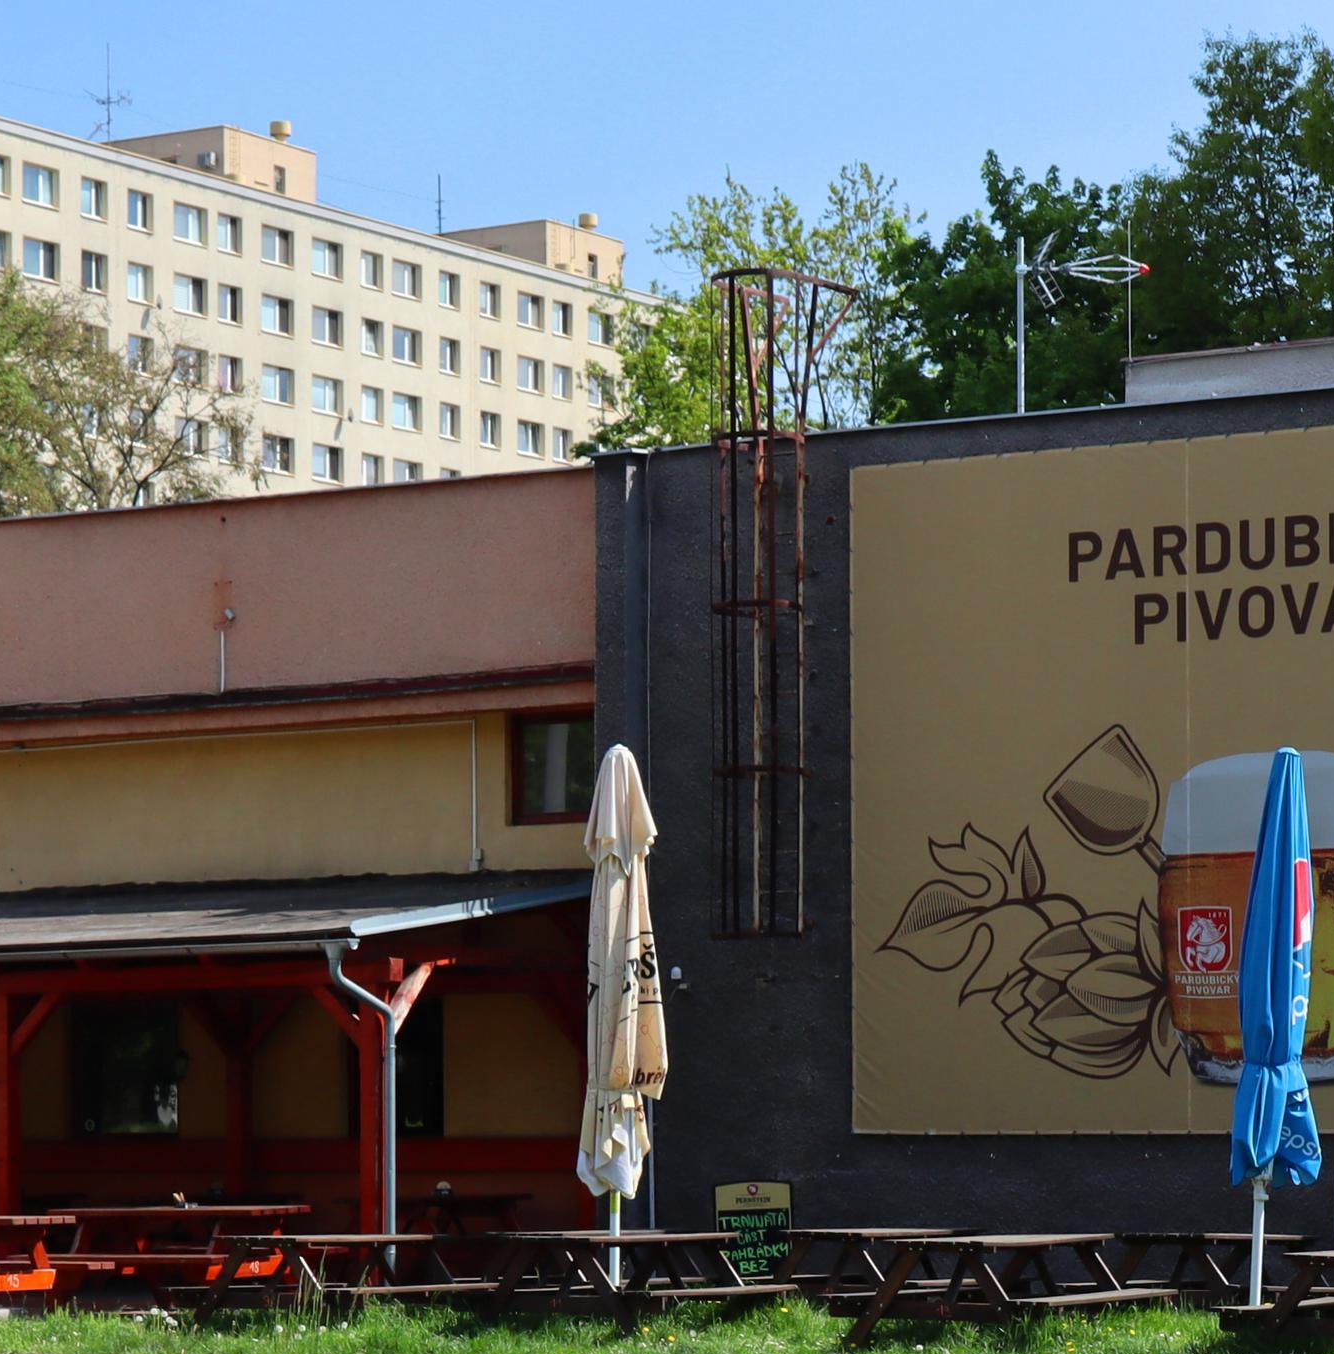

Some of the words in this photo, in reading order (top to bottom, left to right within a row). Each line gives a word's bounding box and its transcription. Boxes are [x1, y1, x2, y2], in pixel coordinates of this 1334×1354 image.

[1185, 985, 1231, 995] PIVOVAR
[739, 1259, 769, 1275] BEZ
[7, 1273, 20, 1289] 15
